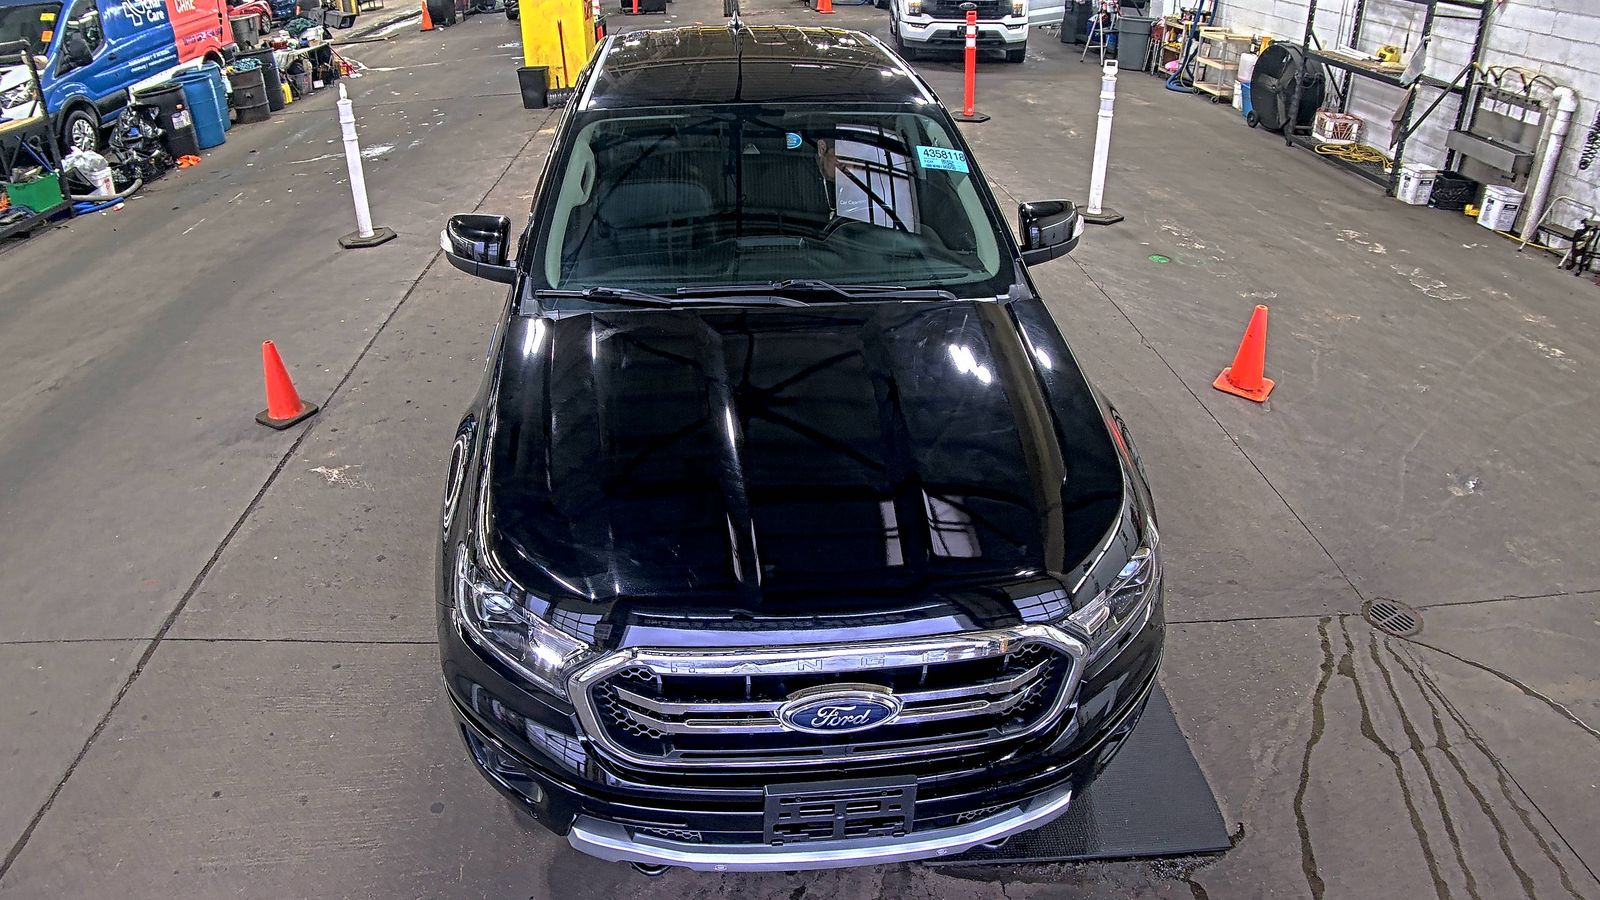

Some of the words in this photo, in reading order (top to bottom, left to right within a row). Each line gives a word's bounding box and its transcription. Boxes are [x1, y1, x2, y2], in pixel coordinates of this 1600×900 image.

[147, 10, 165, 22] Care
[923, 149, 966, 161] 4358118
[811, 706, 872, 727] Ford
